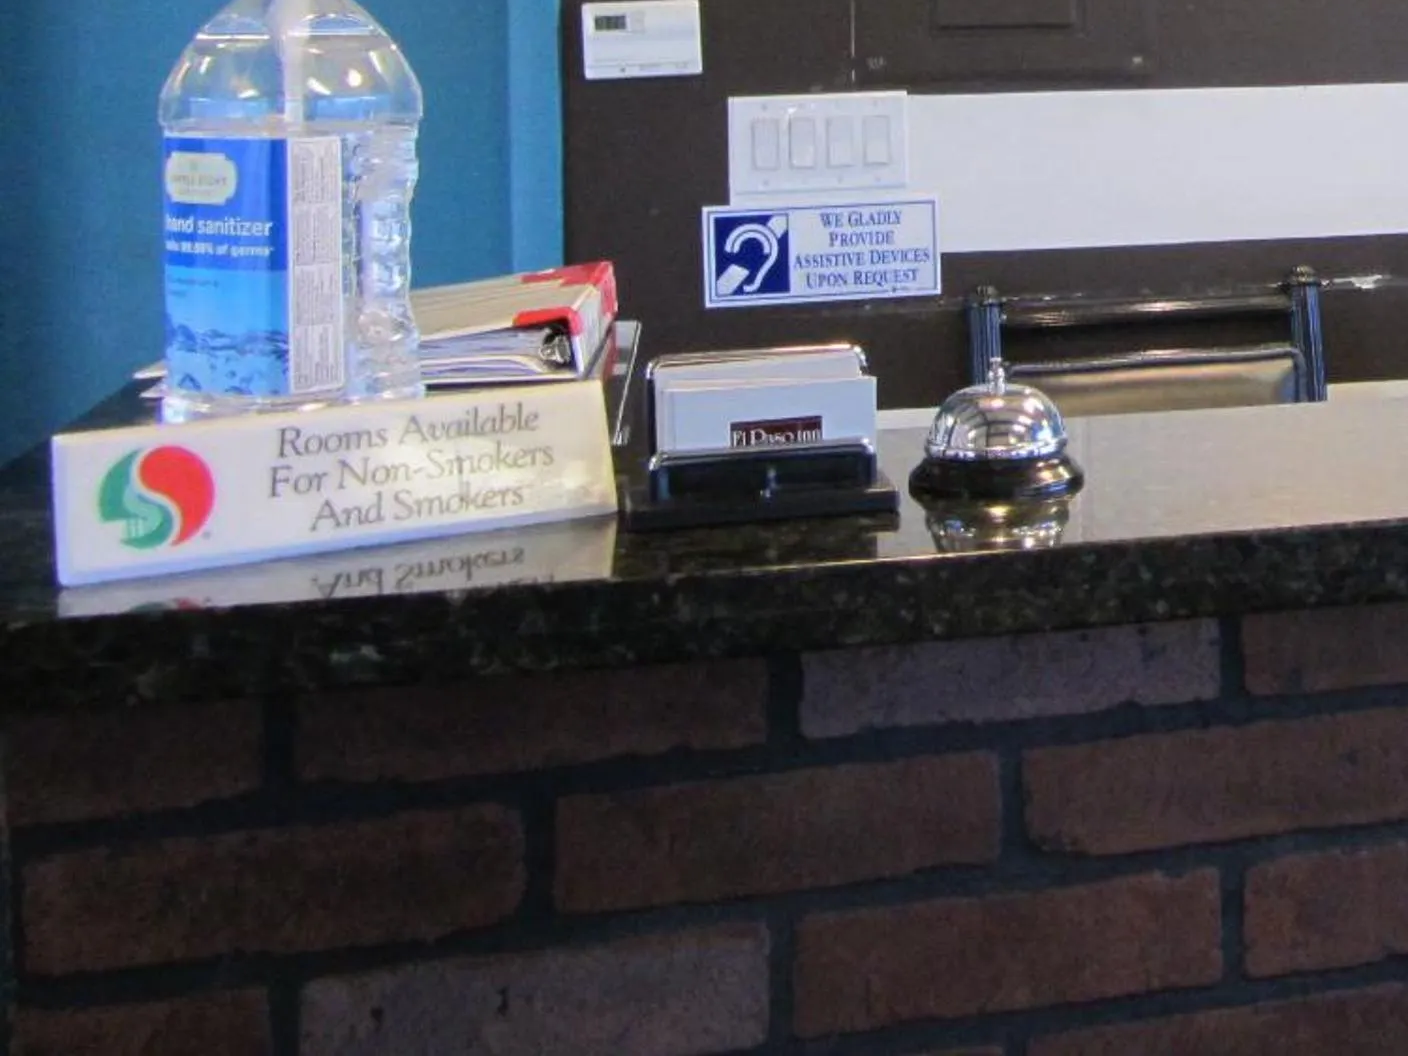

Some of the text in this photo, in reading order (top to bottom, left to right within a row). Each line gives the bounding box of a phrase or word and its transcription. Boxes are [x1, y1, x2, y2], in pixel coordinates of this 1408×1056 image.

[197, 216, 273, 237] sanitizer
[820, 210, 902, 228] WE GLADLY
[828, 231, 895, 247] PROVIDE
[794, 248, 931, 269] ASSISTIVE DEVICES
[806, 268, 919, 289] UPON REQUEST
[276, 401, 540, 458] Rooms Available
[268, 442, 555, 498] For Non-Smokers
[310, 481, 526, 532] And Smokers
